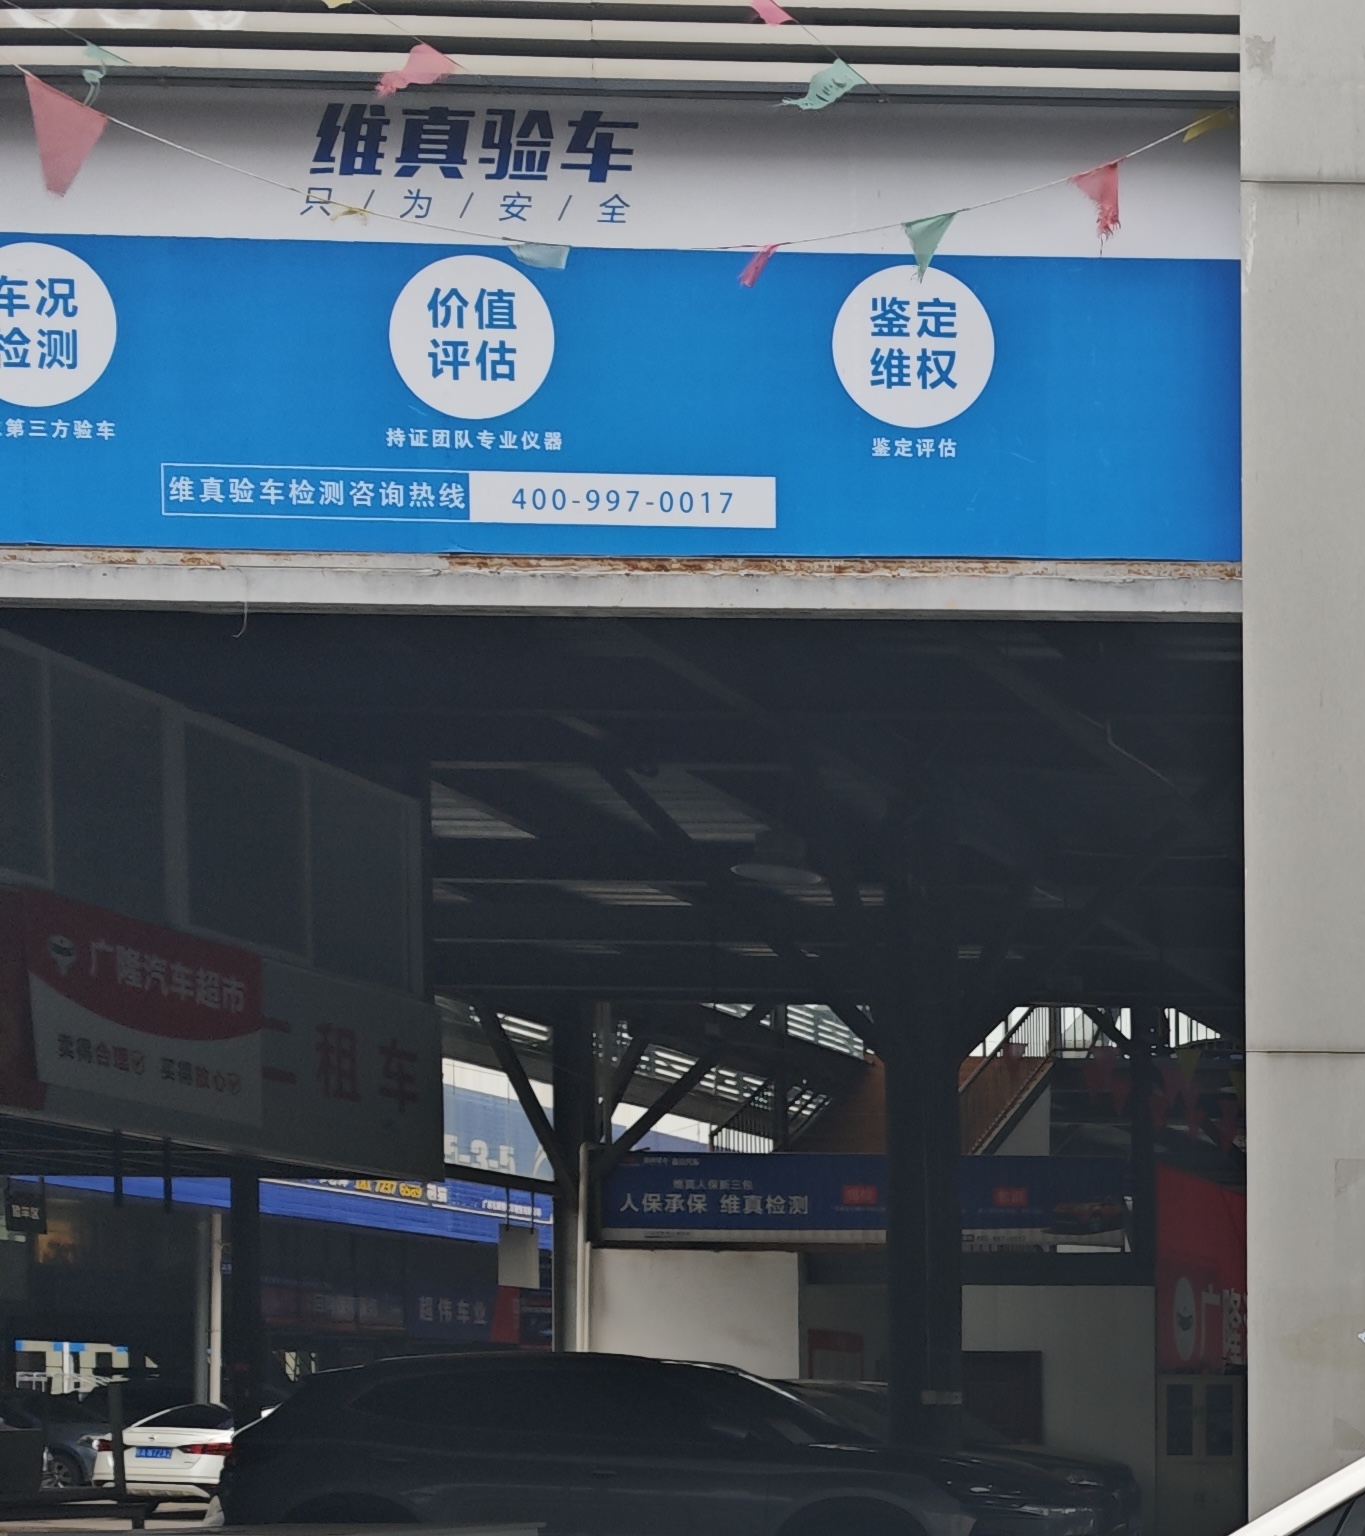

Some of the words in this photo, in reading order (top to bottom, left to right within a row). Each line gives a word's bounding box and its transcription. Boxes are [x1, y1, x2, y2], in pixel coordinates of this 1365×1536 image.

[309, 103, 640, 183] 维真验车
[0, 275, 79, 318] 车况
[427, 287, 518, 331] 价值
[870, 297, 959, 339] 鉴定
[0, 327, 79, 370] 检测
[428, 340, 518, 383] 评估
[870, 348, 959, 391] 维权
[0, 418, 116, 441] 第三方验车
[386, 428, 563, 452] 持证团队专业仪器
[871, 437, 958, 459] 鉴定评估
[169, 475, 466, 511] 维真验车检测咨询热线
[511, 487, 735, 516] 400-997-0017
[89, 938, 246, 1014] 广隆汽车超市
[619, 1193, 709, 1214] 人保承保
[719, 1194, 809, 1216] 维真检测
[418, 1295, 487, 1326] 超伟车业
